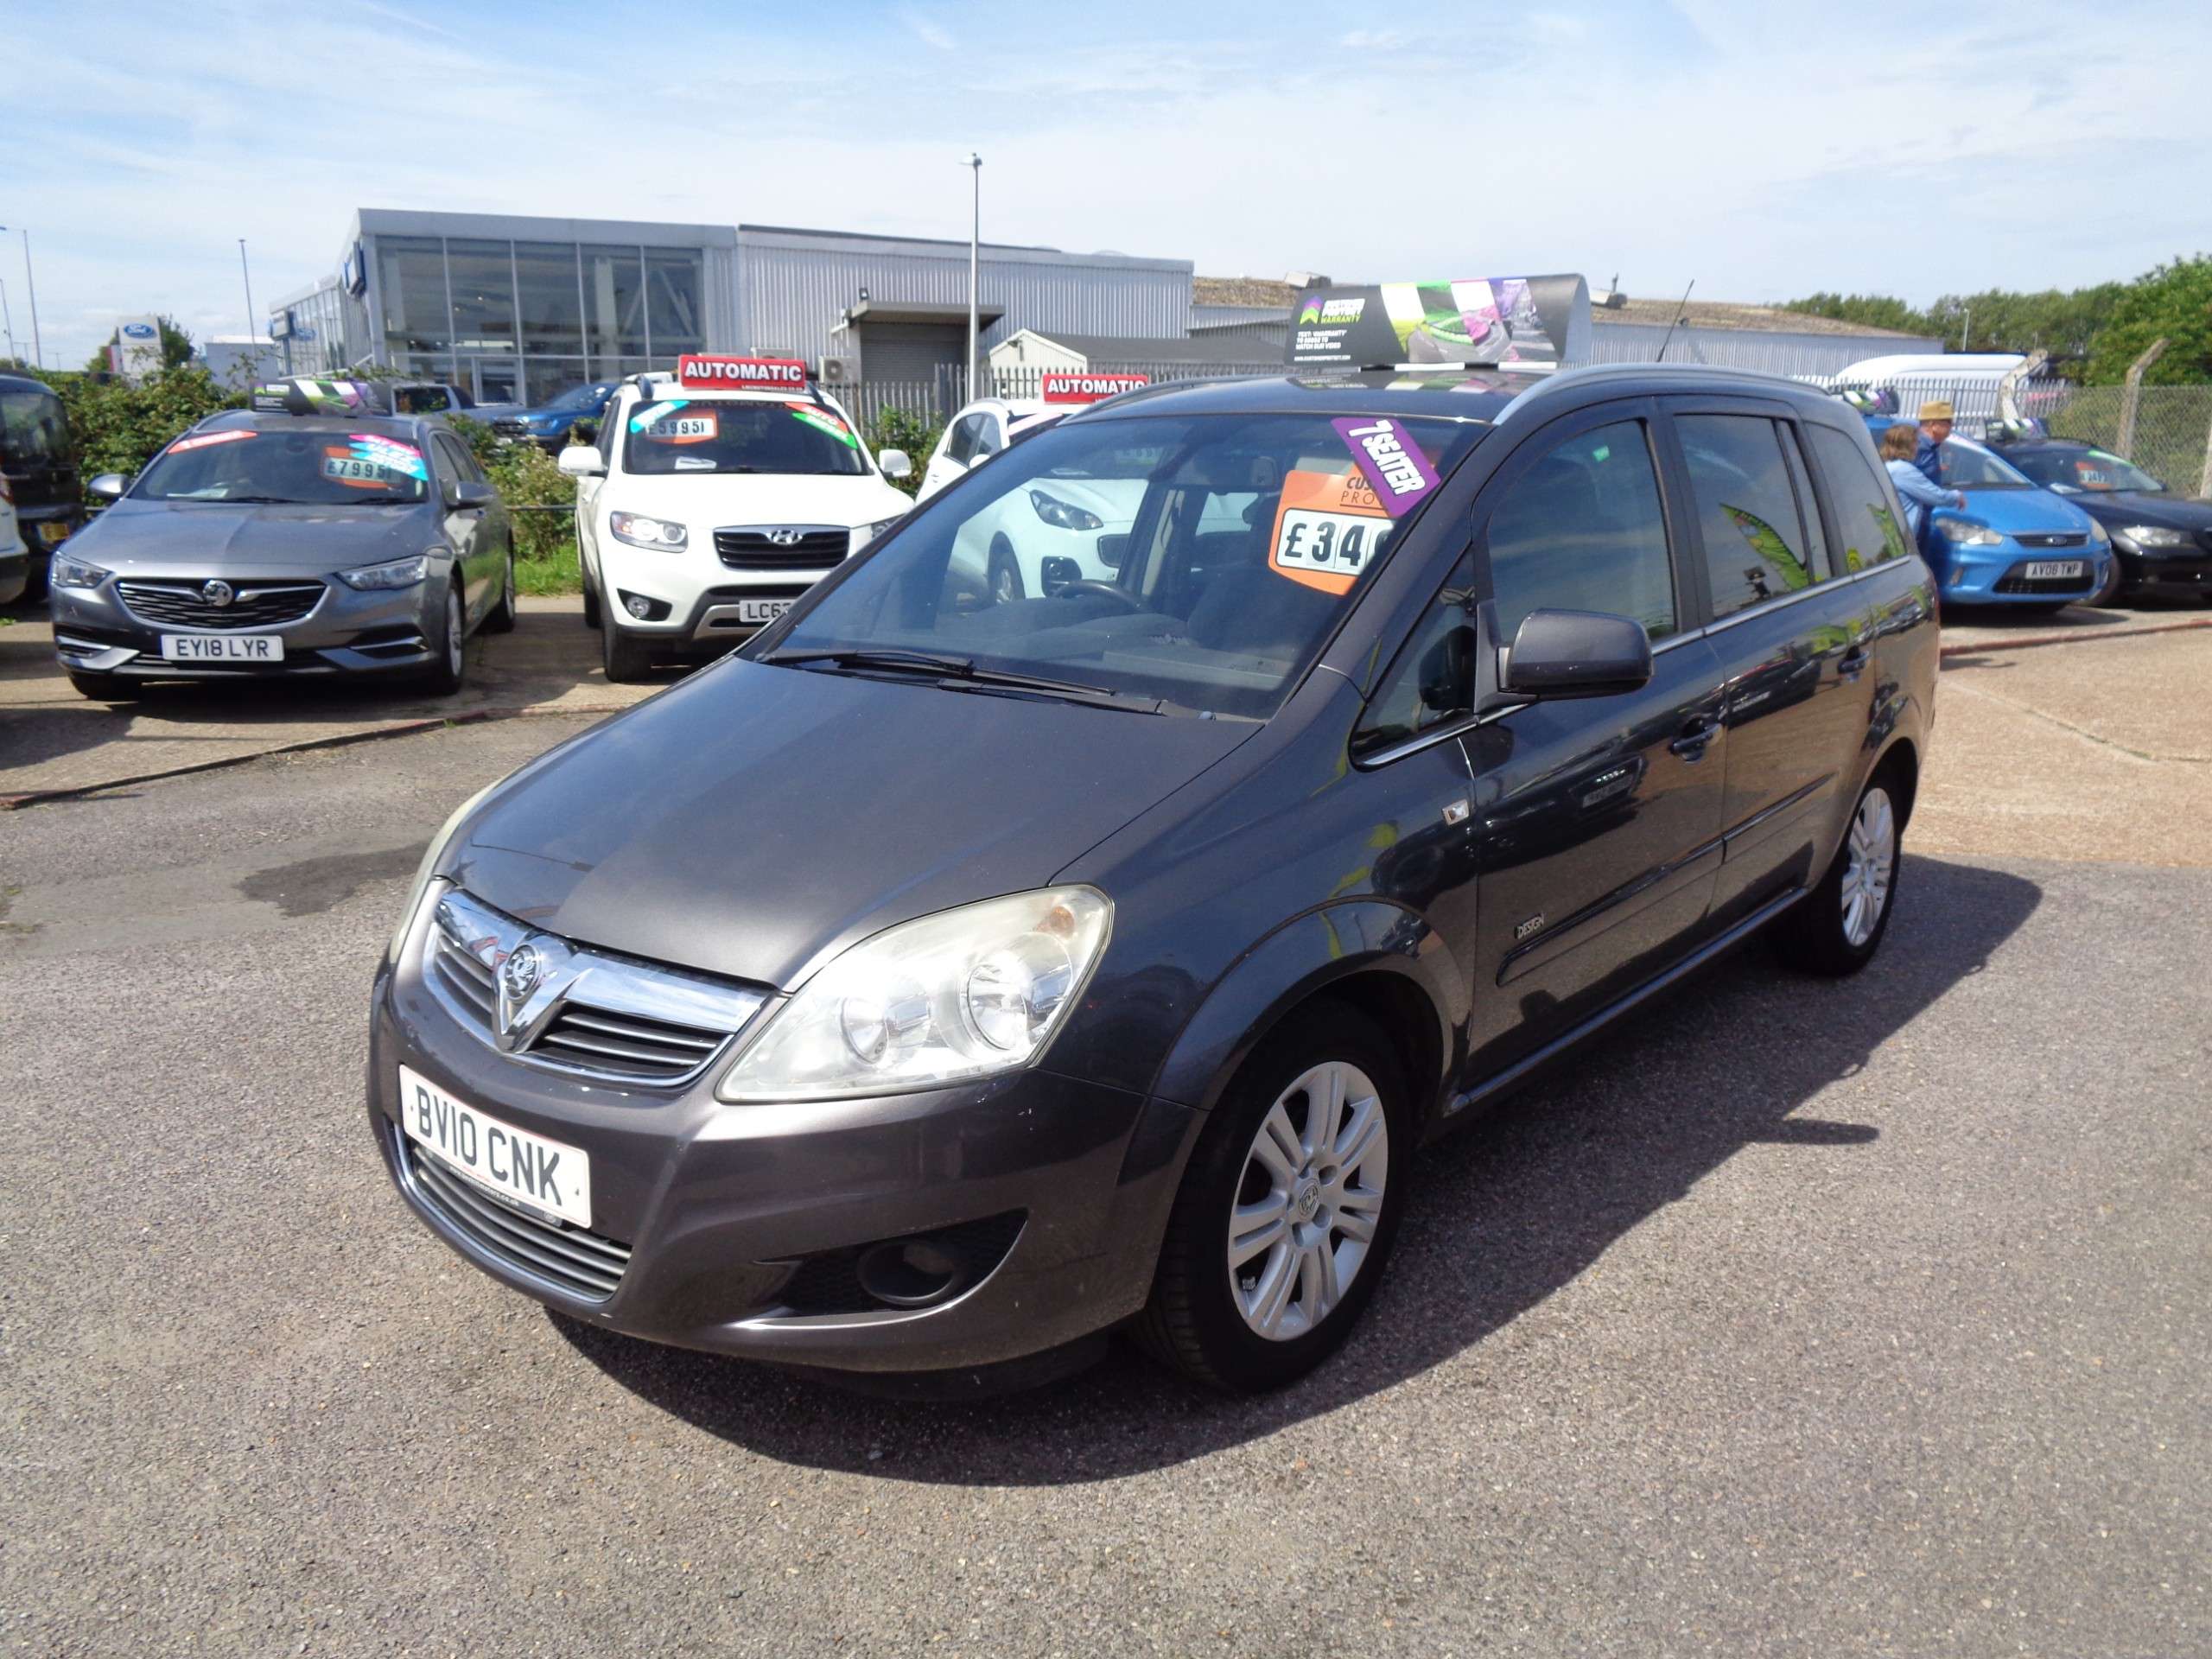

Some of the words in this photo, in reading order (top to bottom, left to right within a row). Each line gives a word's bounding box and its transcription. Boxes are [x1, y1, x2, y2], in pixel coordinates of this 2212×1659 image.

[1321, 313, 1361, 324] WARRANTY
[684, 361, 802, 382] AUTOMATIC
[176, 639, 223, 657] EY18
[229, 639, 269, 657] LYR
[1517, 912, 1545, 940] DESIGN
[416, 1084, 477, 1166] BV10
[487, 1126, 563, 1207] CNK
